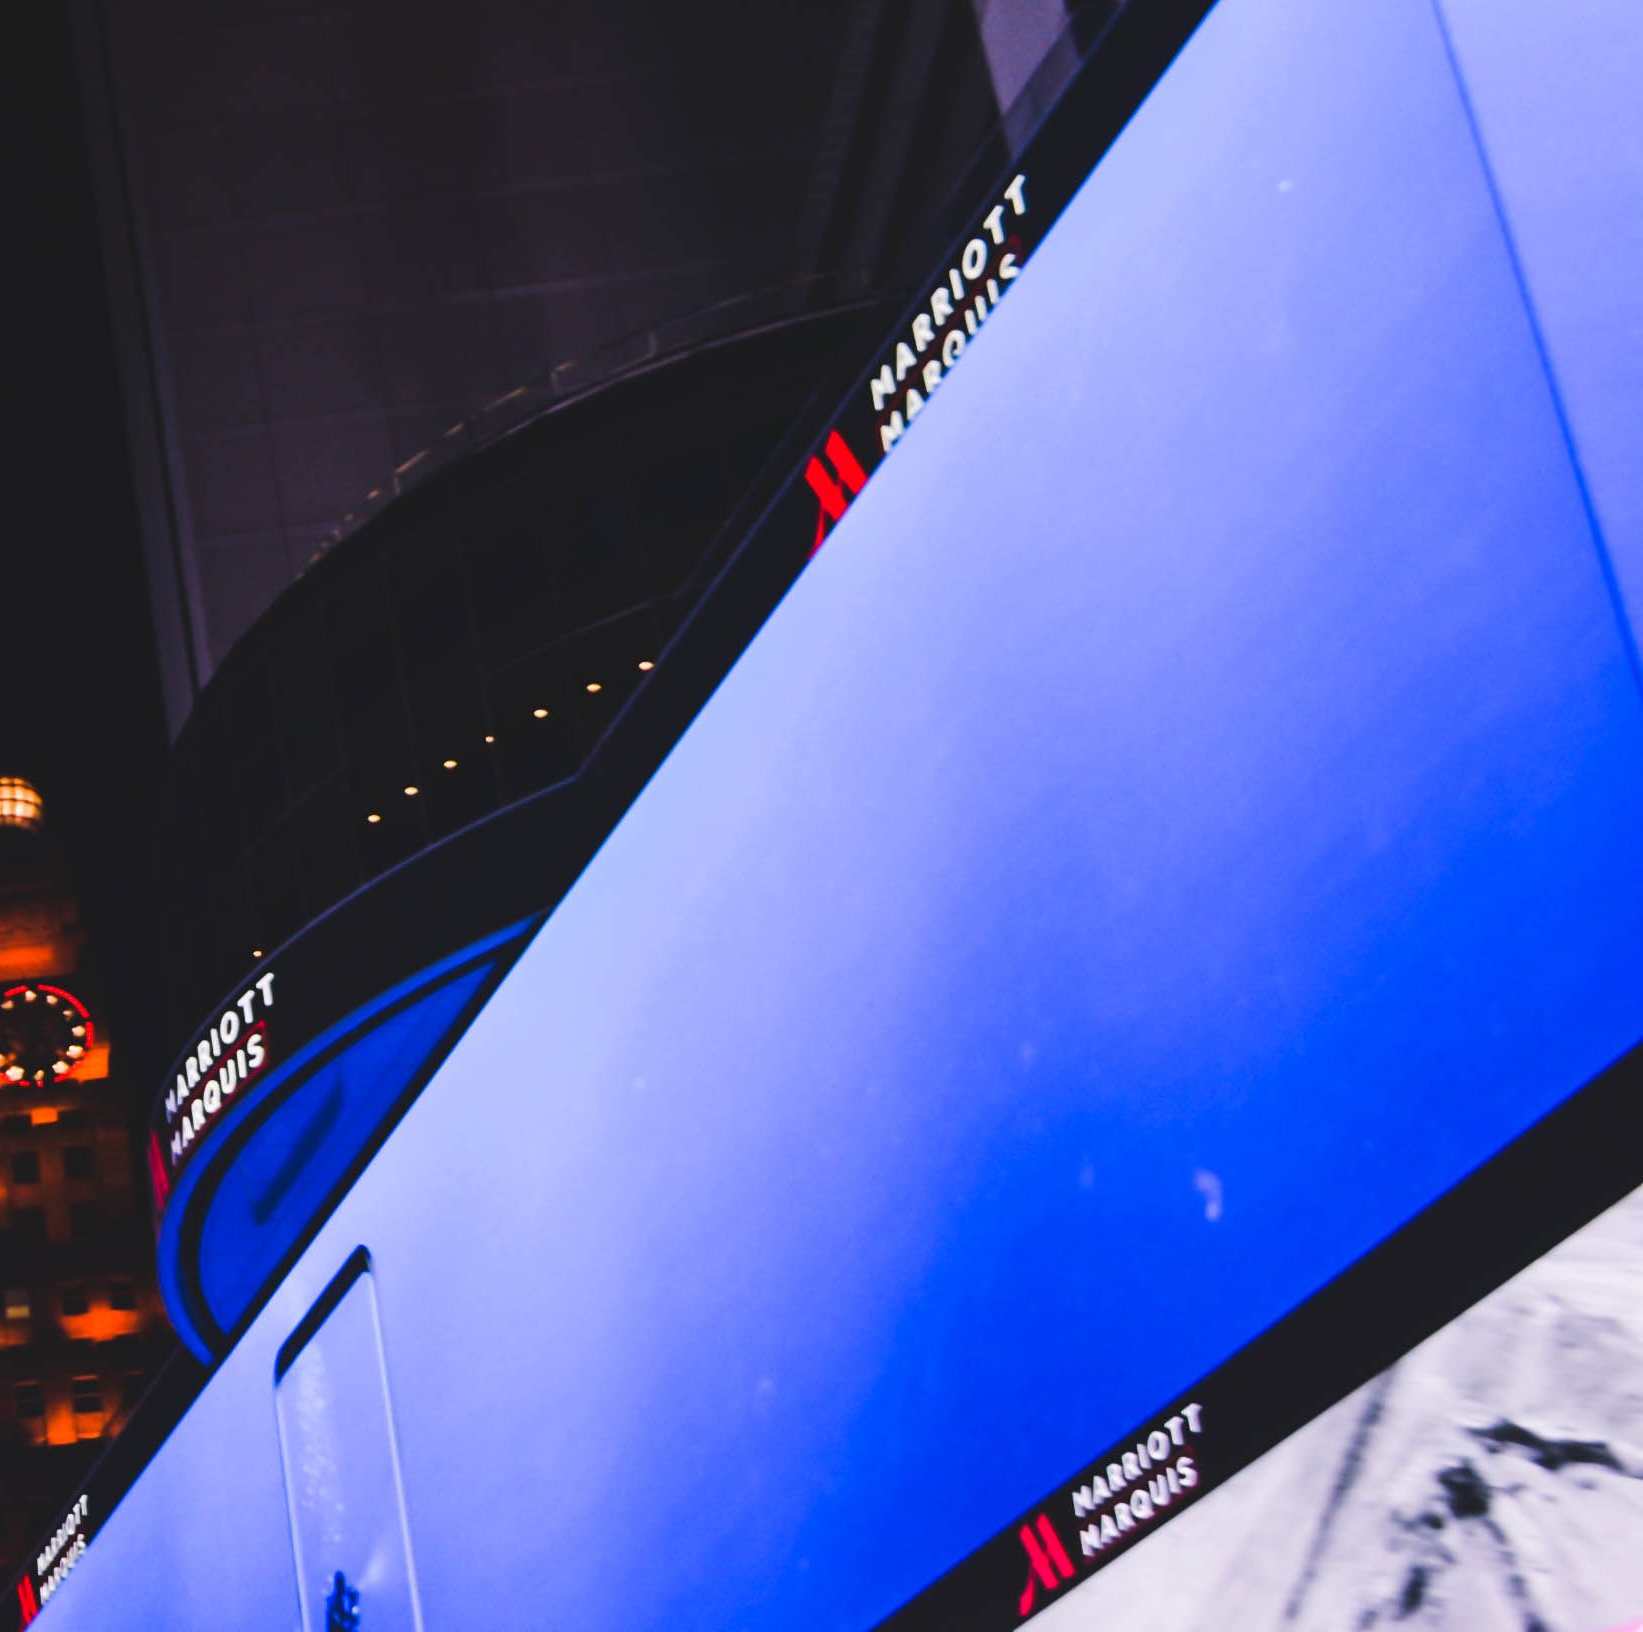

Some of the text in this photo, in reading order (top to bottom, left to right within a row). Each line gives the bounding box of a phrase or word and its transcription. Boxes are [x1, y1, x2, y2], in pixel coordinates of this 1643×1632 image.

[870, 173, 1027, 412] MARRIOTT
[879, 252, 1020, 453] MARQUIS
[165, 971, 275, 1124] MARRIOTT
[170, 1032, 265, 1166] MARQUIS
[1071, 1402, 1203, 1518] MARRIOTT
[1078, 1455, 1200, 1557] MARQUIS
[36, 1494, 89, 1576] MARRIOTT
[39, 1532, 87, 1606] MARQUIS
